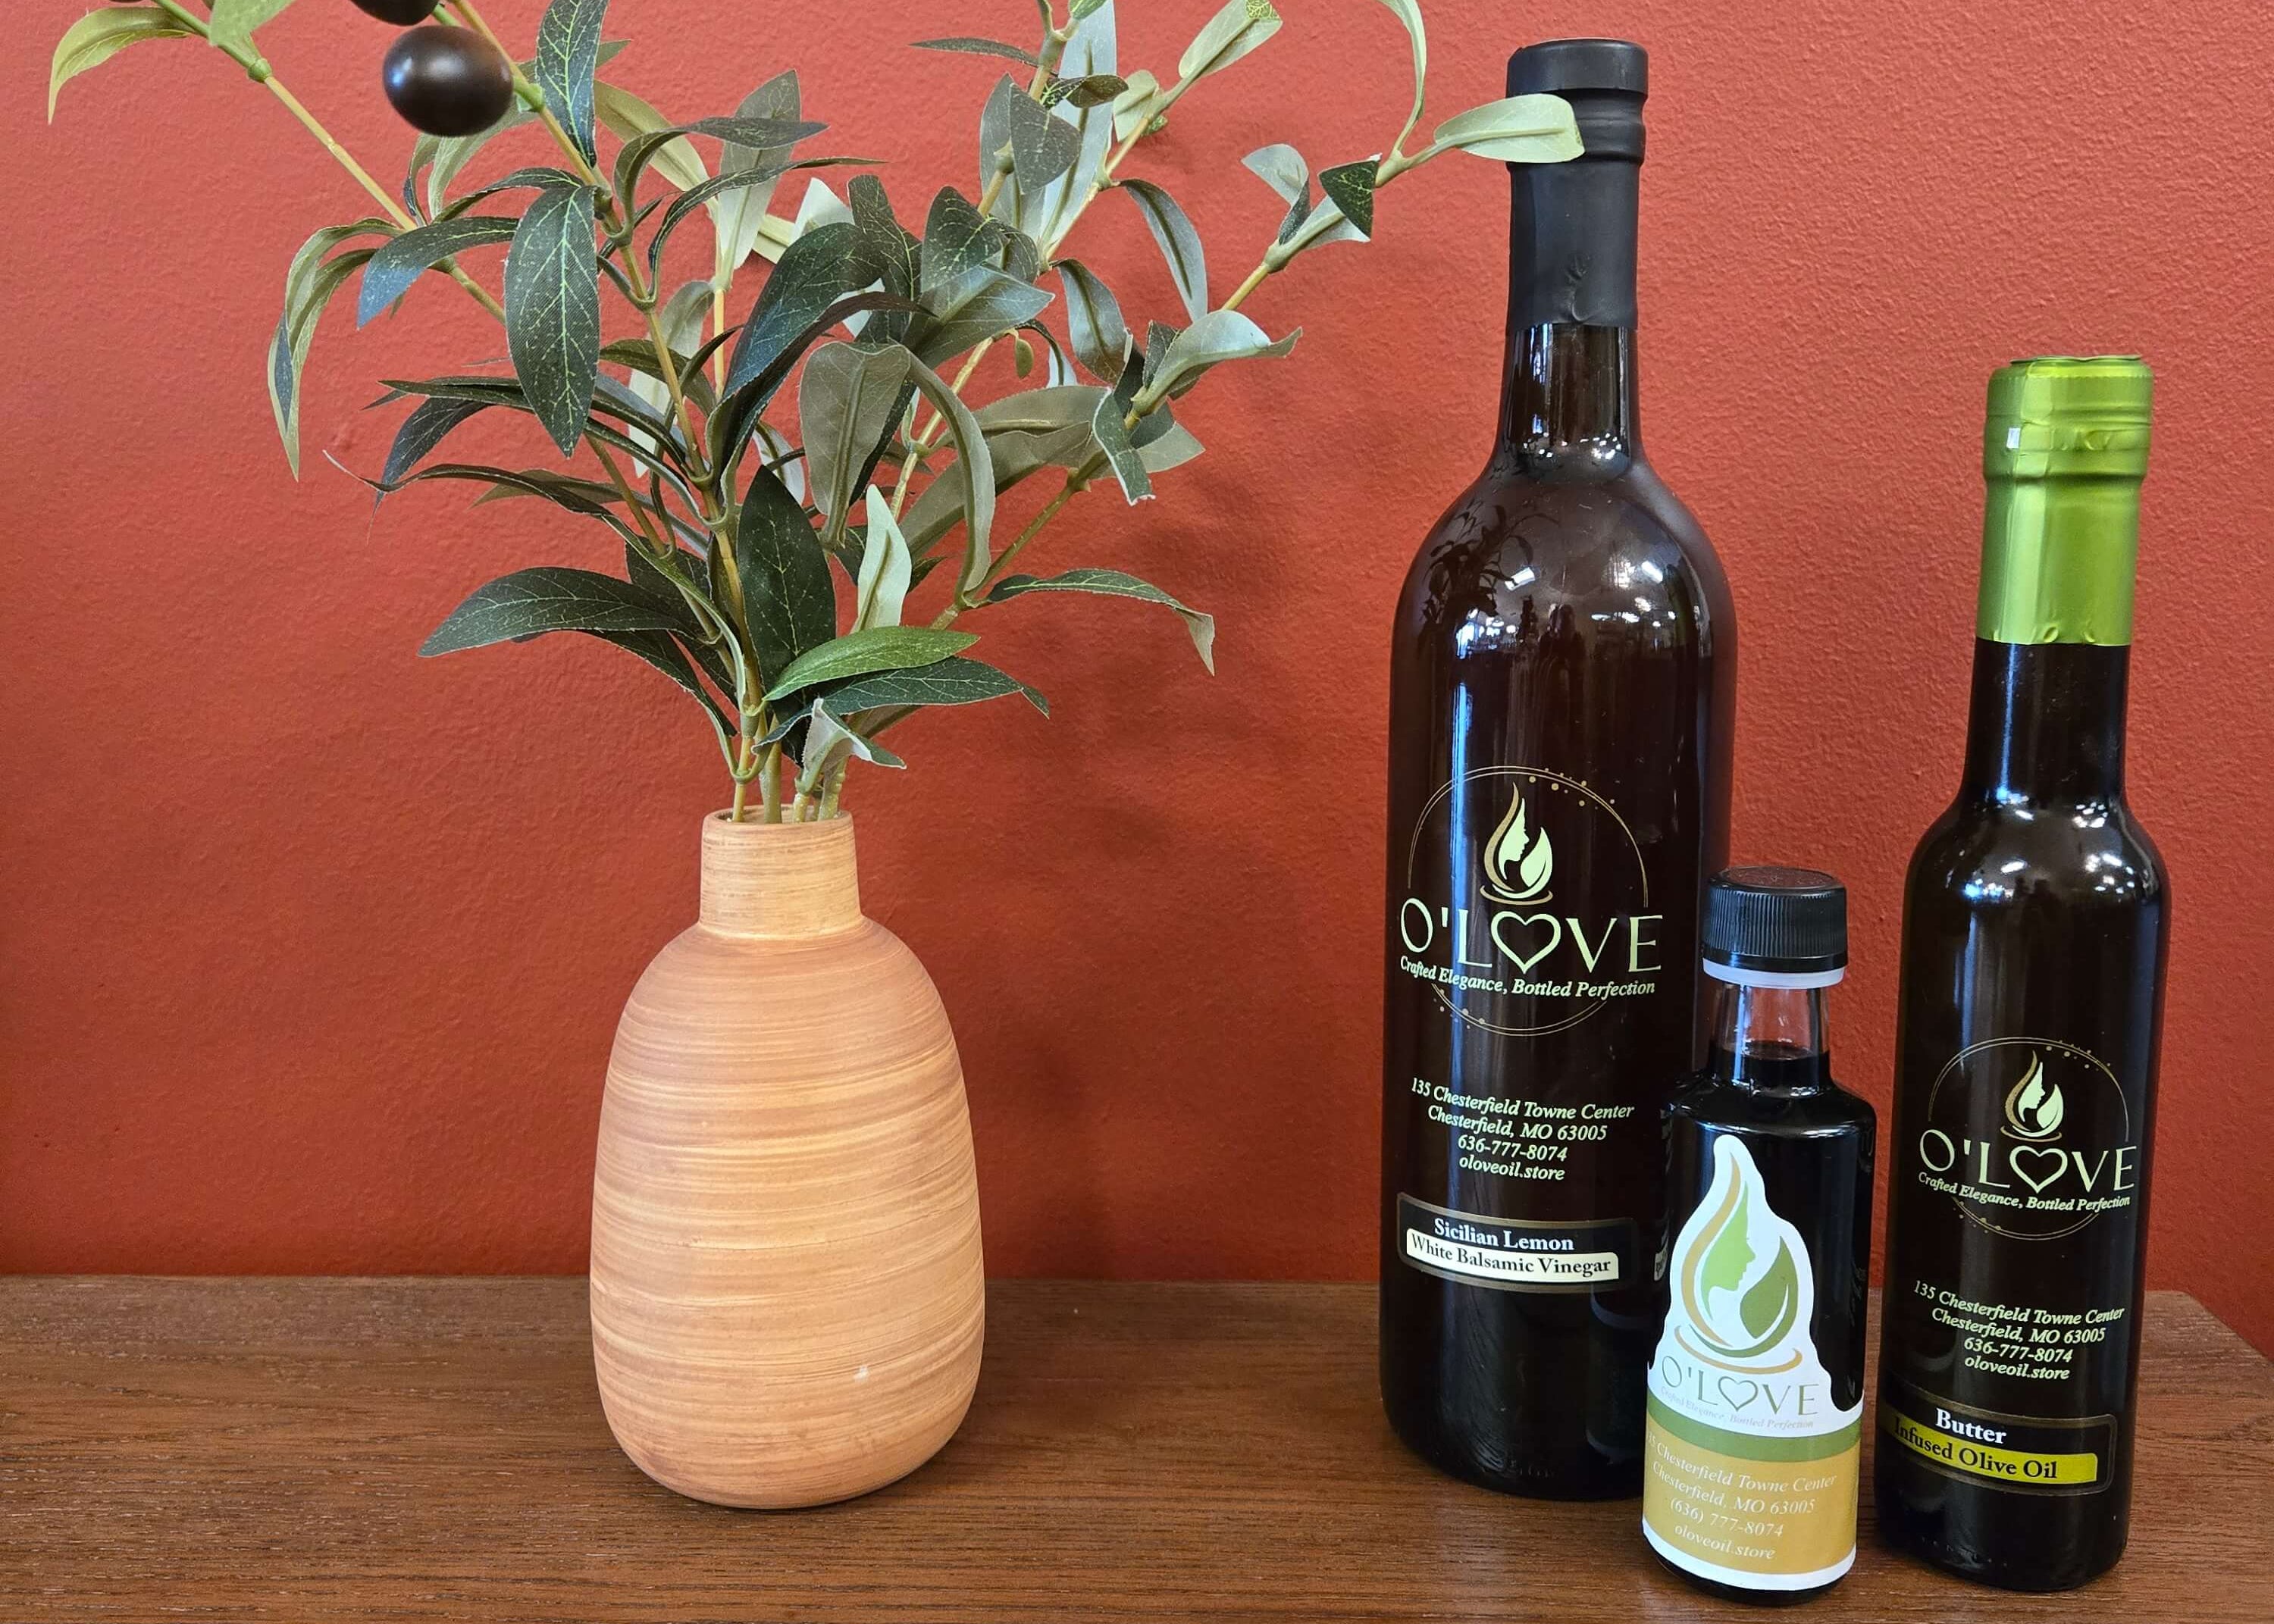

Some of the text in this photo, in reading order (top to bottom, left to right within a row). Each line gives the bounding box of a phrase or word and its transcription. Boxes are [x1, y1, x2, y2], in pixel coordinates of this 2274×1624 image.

[1400, 956, 1655, 1000] Crafted Elegance, Bottled Perfection
[1411, 1077, 1634, 1119] 135 Chesterfield Towne Center
[1428, 1105, 1608, 1141] Chesterfield, MO 63005
[1458, 1134, 1568, 1162] 636-777-8074
[1459, 1155, 1565, 1181] oloveoil.store
[1918, 1172, 2130, 1213] Crafted Elegance, Bottled Perfection
[1434, 1218, 1574, 1250] Sicilian Lemon
[1411, 1234, 1611, 1278] White Balsamic Vinegar
[1914, 1280, 2125, 1325] 135 Chesterfield Towne Center
[1932, 1307, 2106, 1344] Chesterfield, MO 63005
[1963, 1337, 2073, 1363] 636-777-8074
[1965, 1356, 2070, 1380] oloveoil.store
[1935, 1407, 2007, 1444] Butter
[1895, 1416, 2057, 1478] Infused Olive Oil
[1657, 1442, 1734, 1485] Chesterfield
[1738, 1474, 1788, 1492] Towne
[1793, 1473, 1837, 1491] Center
[1652, 1461, 1815, 1514] Chesterfield, MO 63005
[1671, 1497, 1784, 1538] (636) 777-8074
[1674, 1525, 1776, 1560] oloveoil.store
